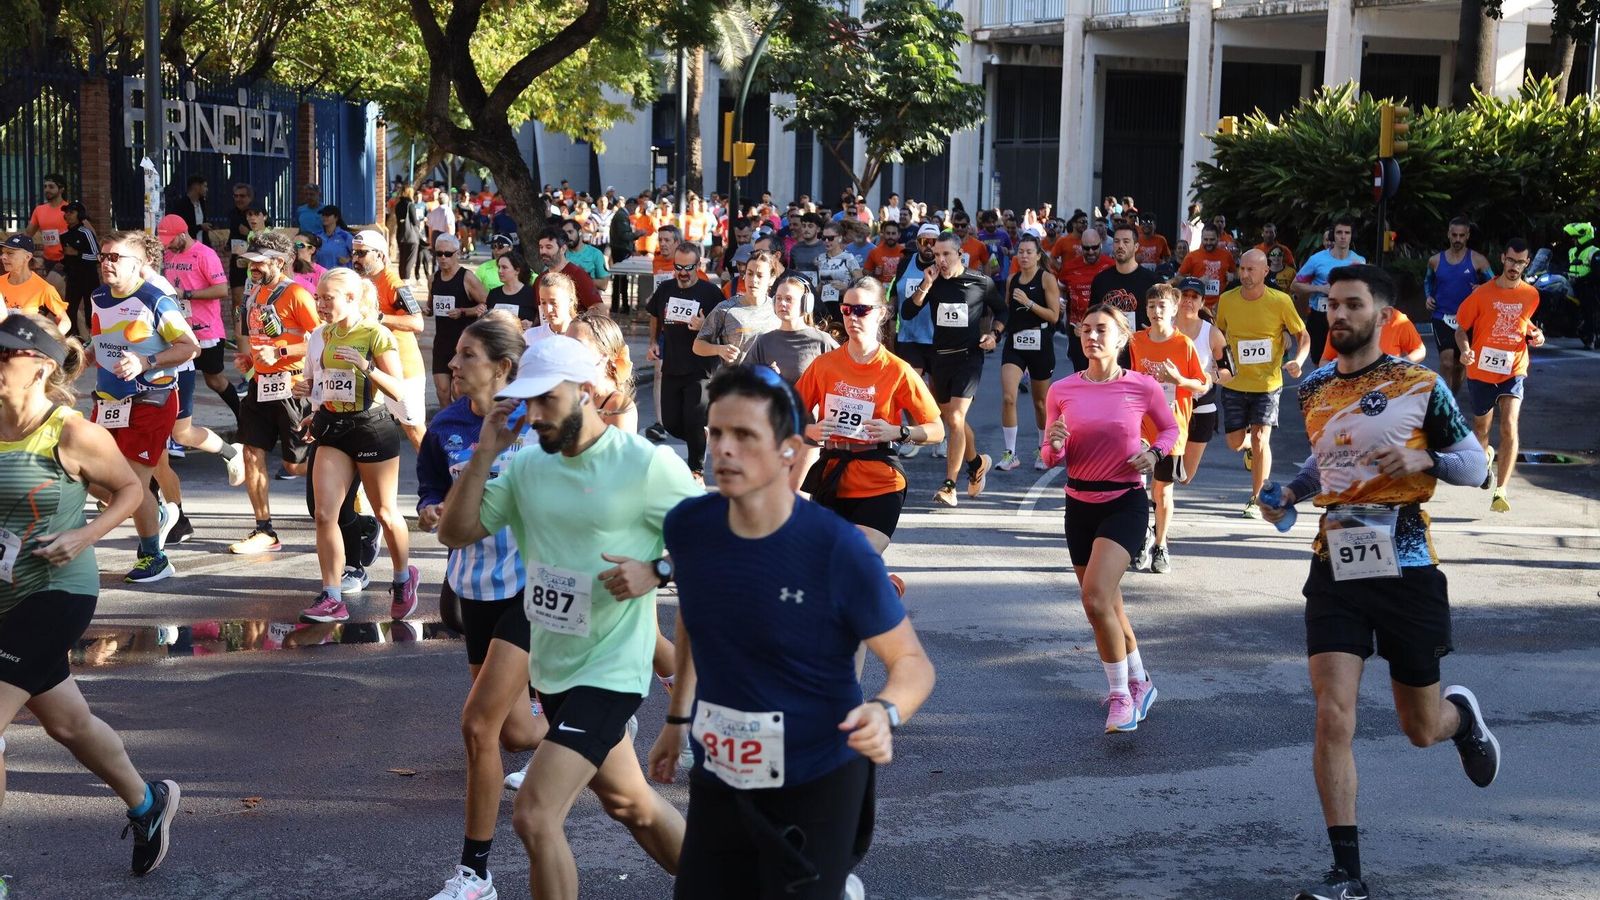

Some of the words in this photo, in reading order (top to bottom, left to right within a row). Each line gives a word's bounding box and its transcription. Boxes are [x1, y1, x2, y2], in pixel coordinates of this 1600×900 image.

[435, 302, 451, 310] 934
[672, 305, 693, 316] 376
[944, 311, 959, 320] 19
[1016, 335, 1036, 344] 625
[99, 342, 129, 351] Málaga
[1242, 347, 1266, 357] 970
[106, 350, 124, 358] 202
[1484, 355, 1506, 367] 751
[262, 382, 286, 393] 583
[324, 379, 353, 391] 1024
[104, 409, 120, 420] 68
[829, 408, 862, 427] 729
[1340, 543, 1382, 564] 971
[532, 585, 575, 613] 897
[703, 732, 763, 765] 812
